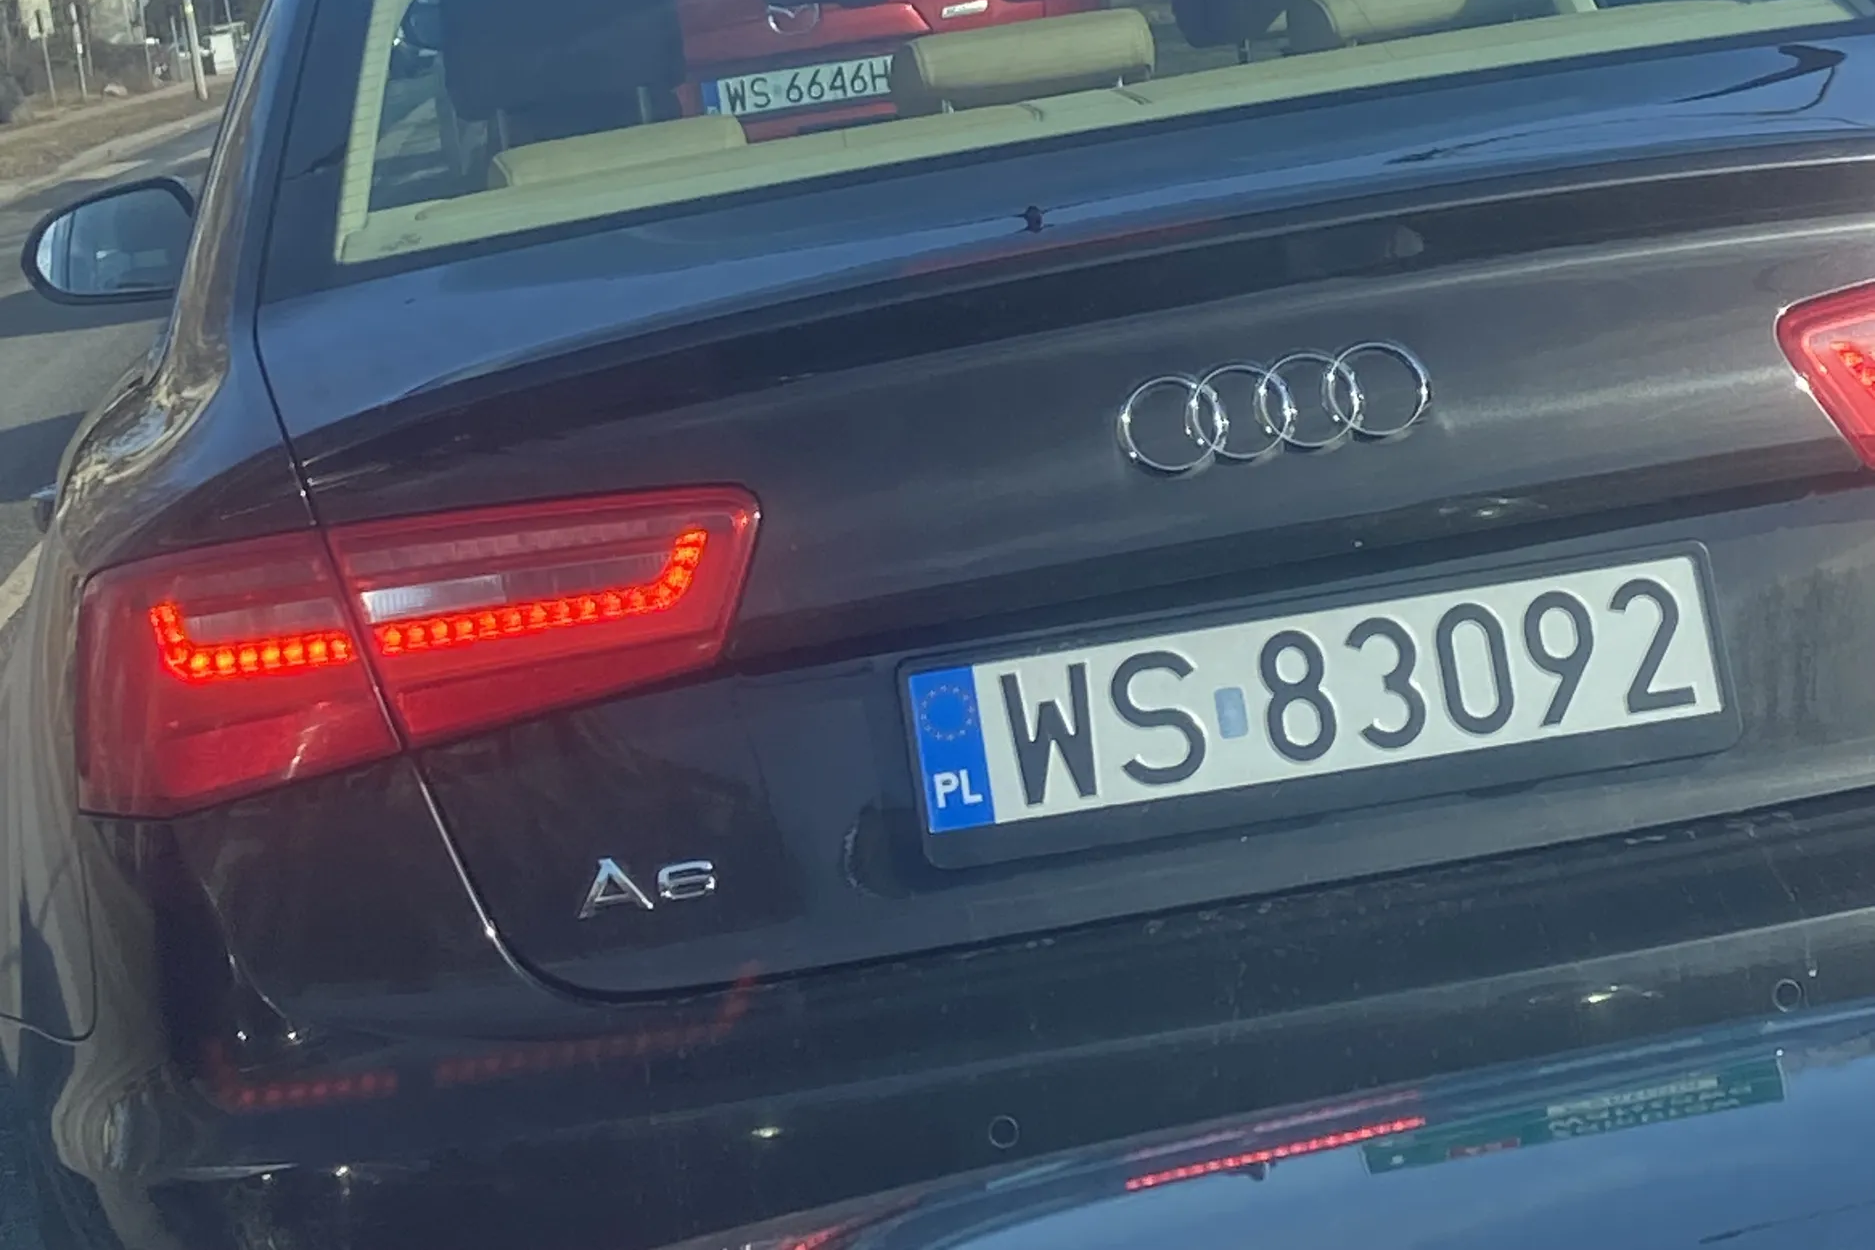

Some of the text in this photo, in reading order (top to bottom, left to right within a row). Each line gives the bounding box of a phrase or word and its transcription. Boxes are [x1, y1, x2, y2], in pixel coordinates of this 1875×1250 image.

[725, 58, 891, 112] WS 6646H
[999, 578, 1697, 807] WS 83092
[933, 769, 984, 809] PL
[577, 857, 716, 919] A6
